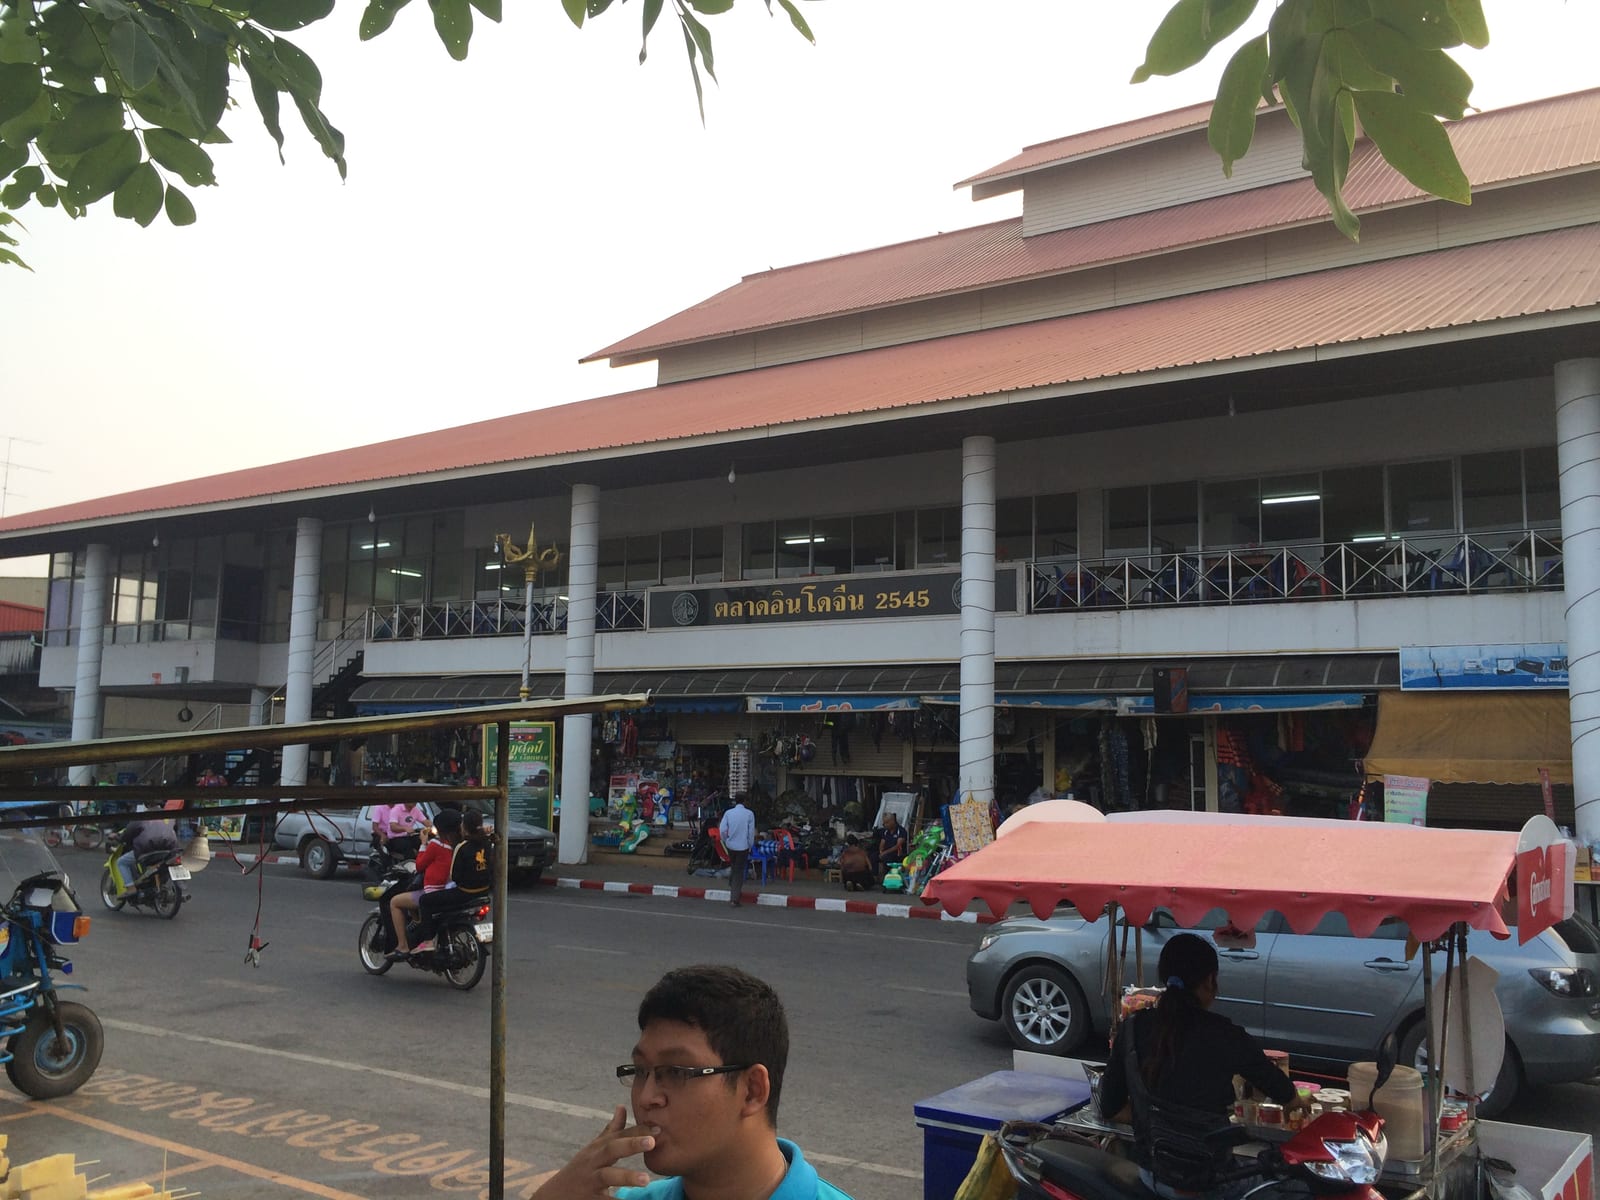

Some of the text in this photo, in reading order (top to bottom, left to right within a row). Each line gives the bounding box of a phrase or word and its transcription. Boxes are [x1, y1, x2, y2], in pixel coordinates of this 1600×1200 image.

[714, 584, 930, 618] ตลาดอินโดจีน 2545
